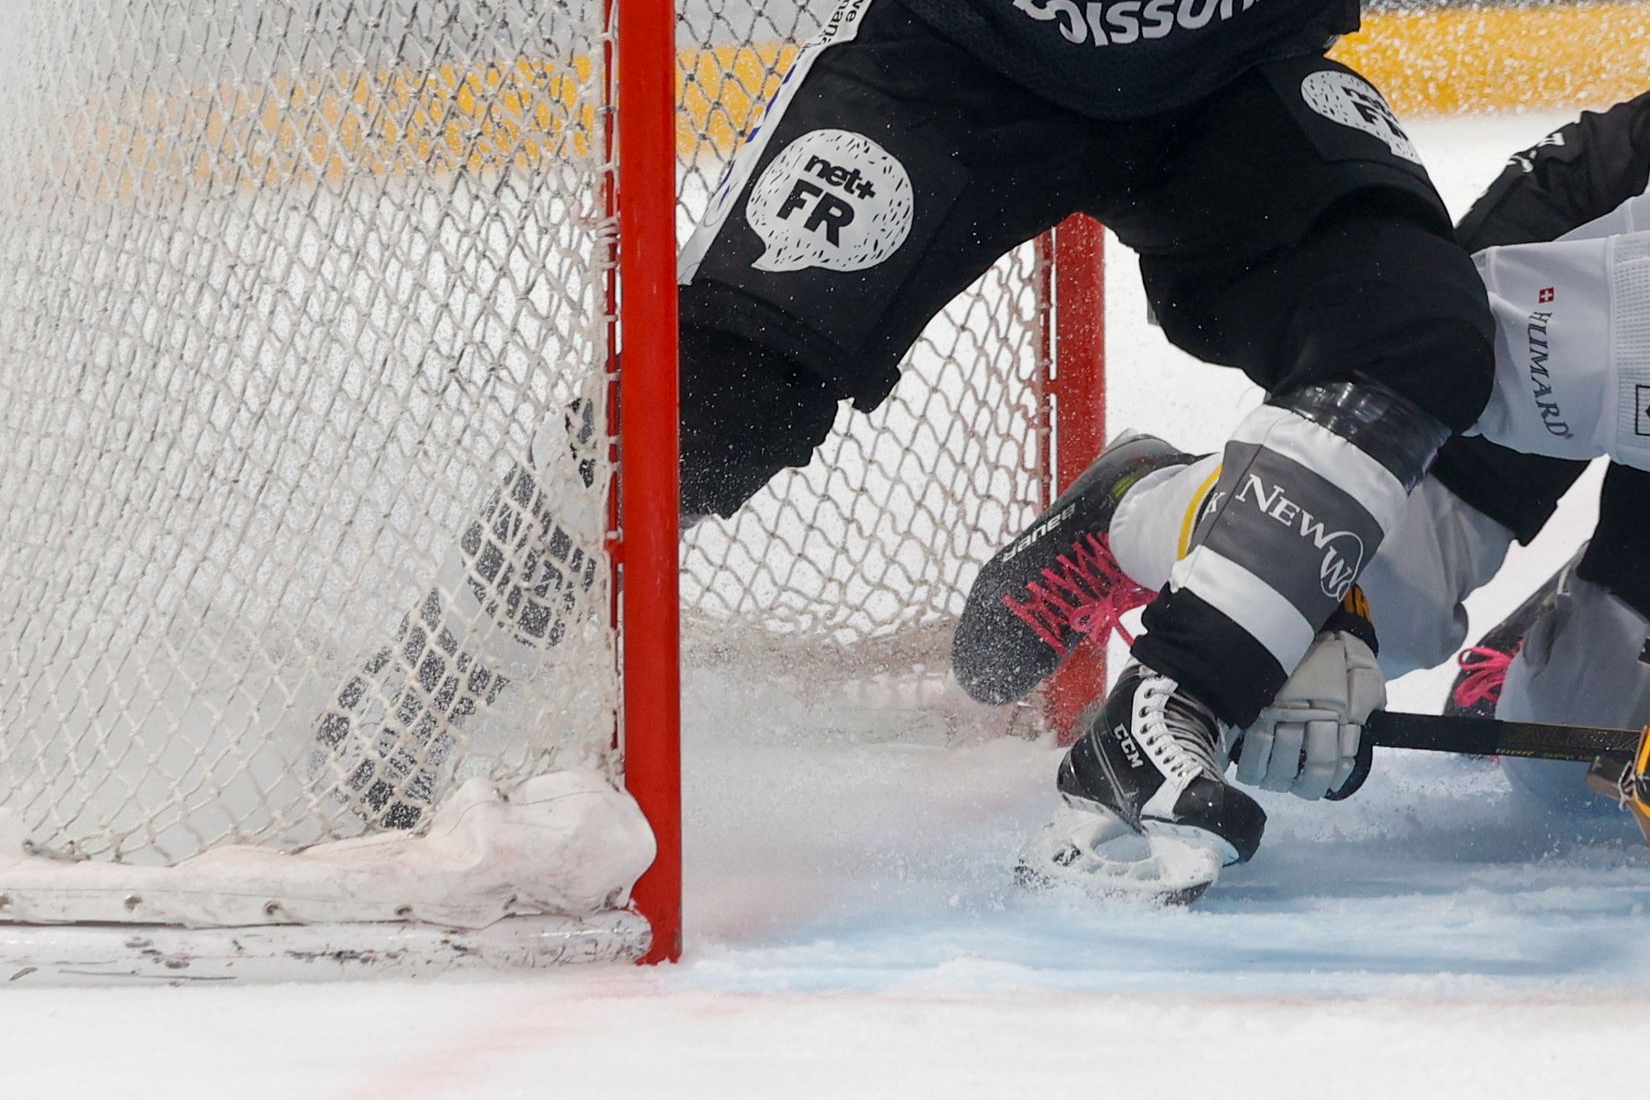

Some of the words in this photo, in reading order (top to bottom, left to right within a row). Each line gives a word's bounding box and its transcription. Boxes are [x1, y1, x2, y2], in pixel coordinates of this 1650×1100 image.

[803, 153, 875, 200] net+
[775, 178, 855, 248] FR
[1002, 502, 1077, 565] BAUER
[1113, 723, 1144, 770] CCM
